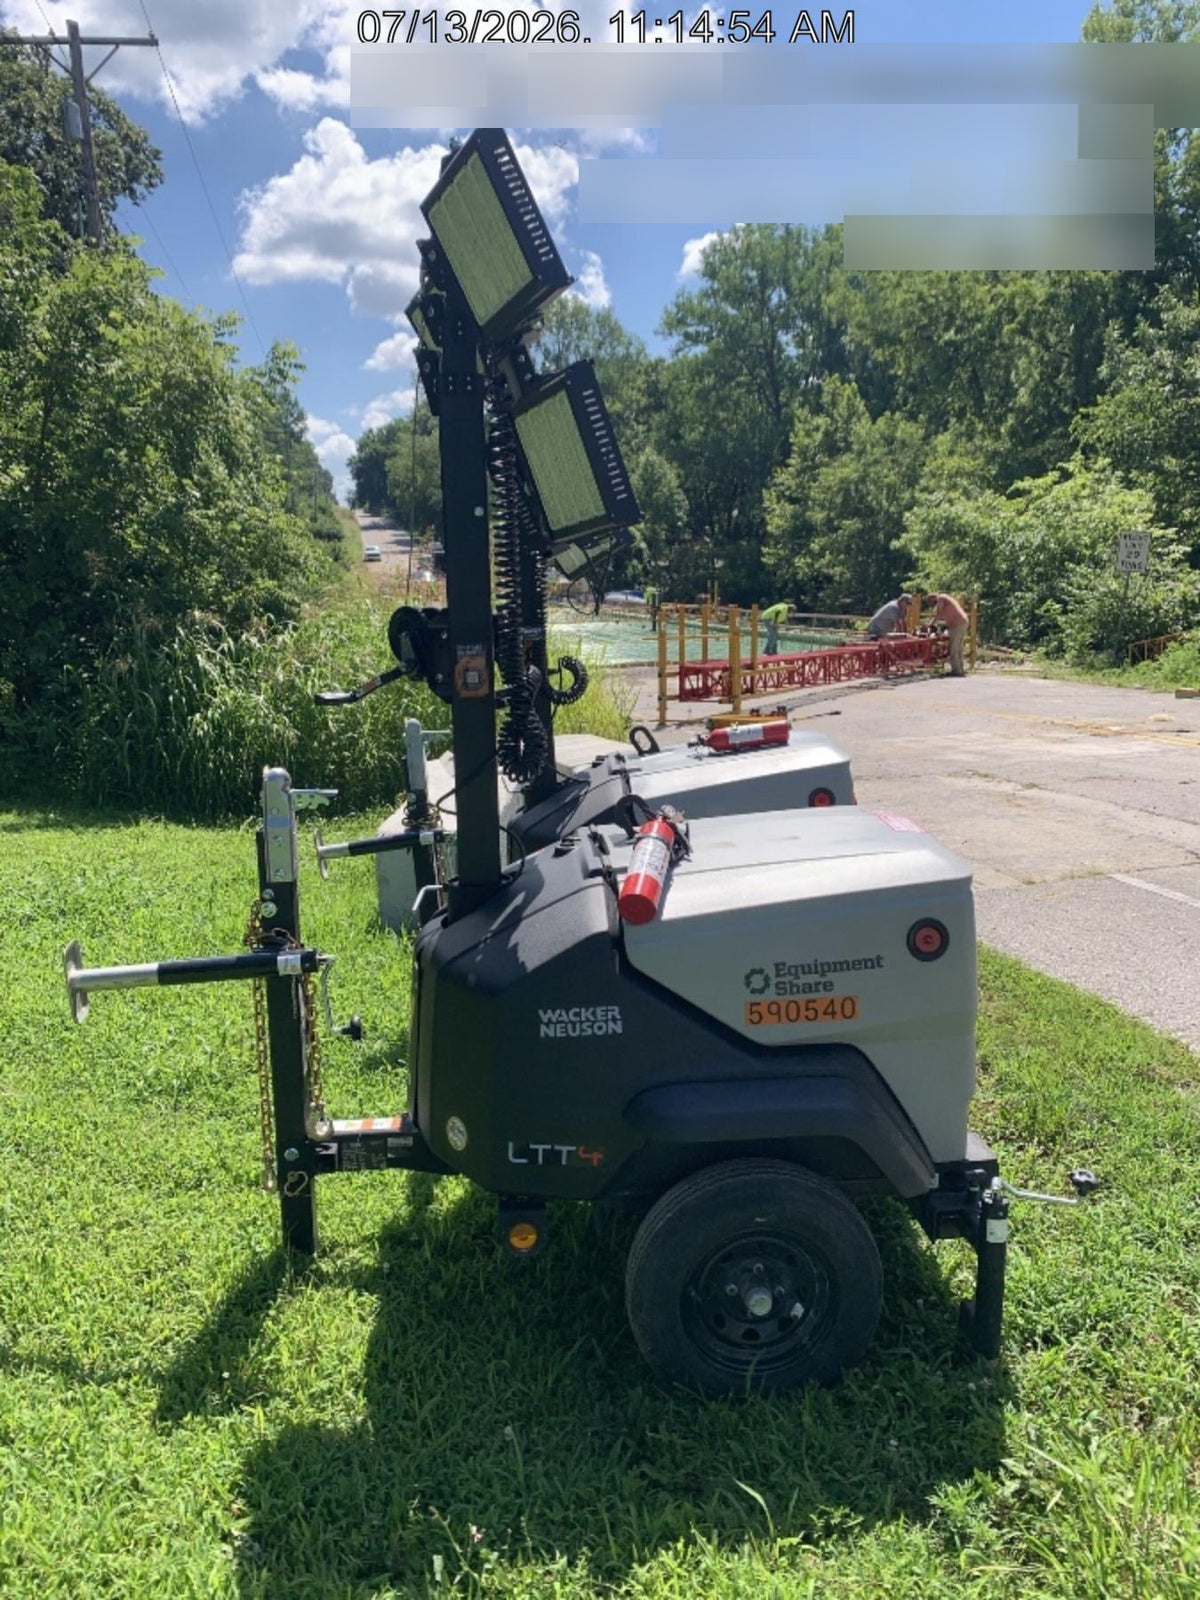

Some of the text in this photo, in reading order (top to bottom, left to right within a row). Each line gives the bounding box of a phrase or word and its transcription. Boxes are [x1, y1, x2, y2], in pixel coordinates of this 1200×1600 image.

[774, 954, 884, 980] Equipment
[774, 979, 834, 996] Share
[538, 1005, 622, 1023] WACKER
[748, 997, 856, 1025] 590540
[539, 1020, 623, 1038] NEUSON
[508, 1141, 603, 1167] LTT4
